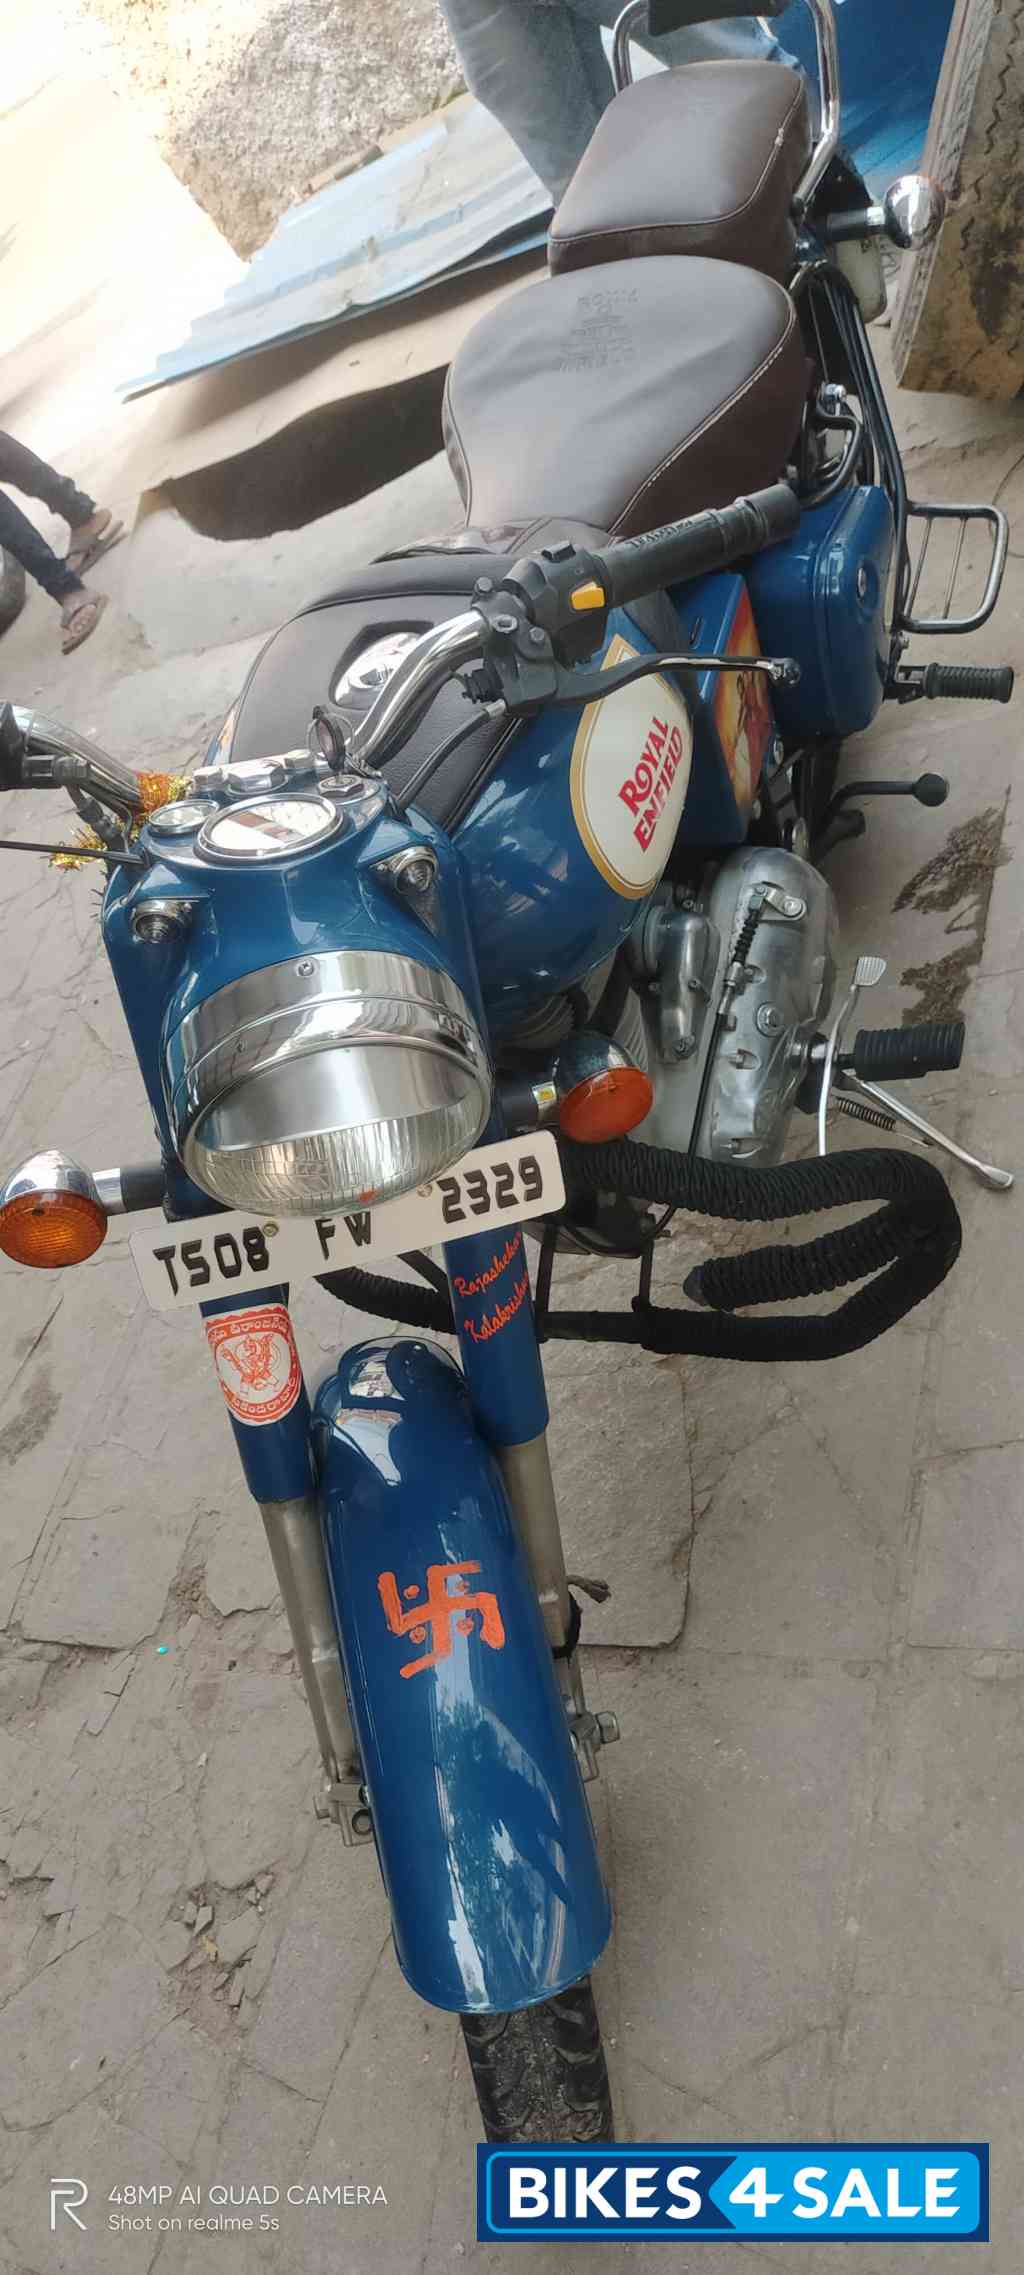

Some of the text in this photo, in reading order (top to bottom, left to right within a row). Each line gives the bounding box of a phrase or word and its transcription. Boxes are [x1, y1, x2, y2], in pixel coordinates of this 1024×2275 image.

[618, 716, 669, 817] ROYAL
[633, 726, 683, 853] ENFIELD
[152, 1155, 544, 1297] TS08 FW 2329
